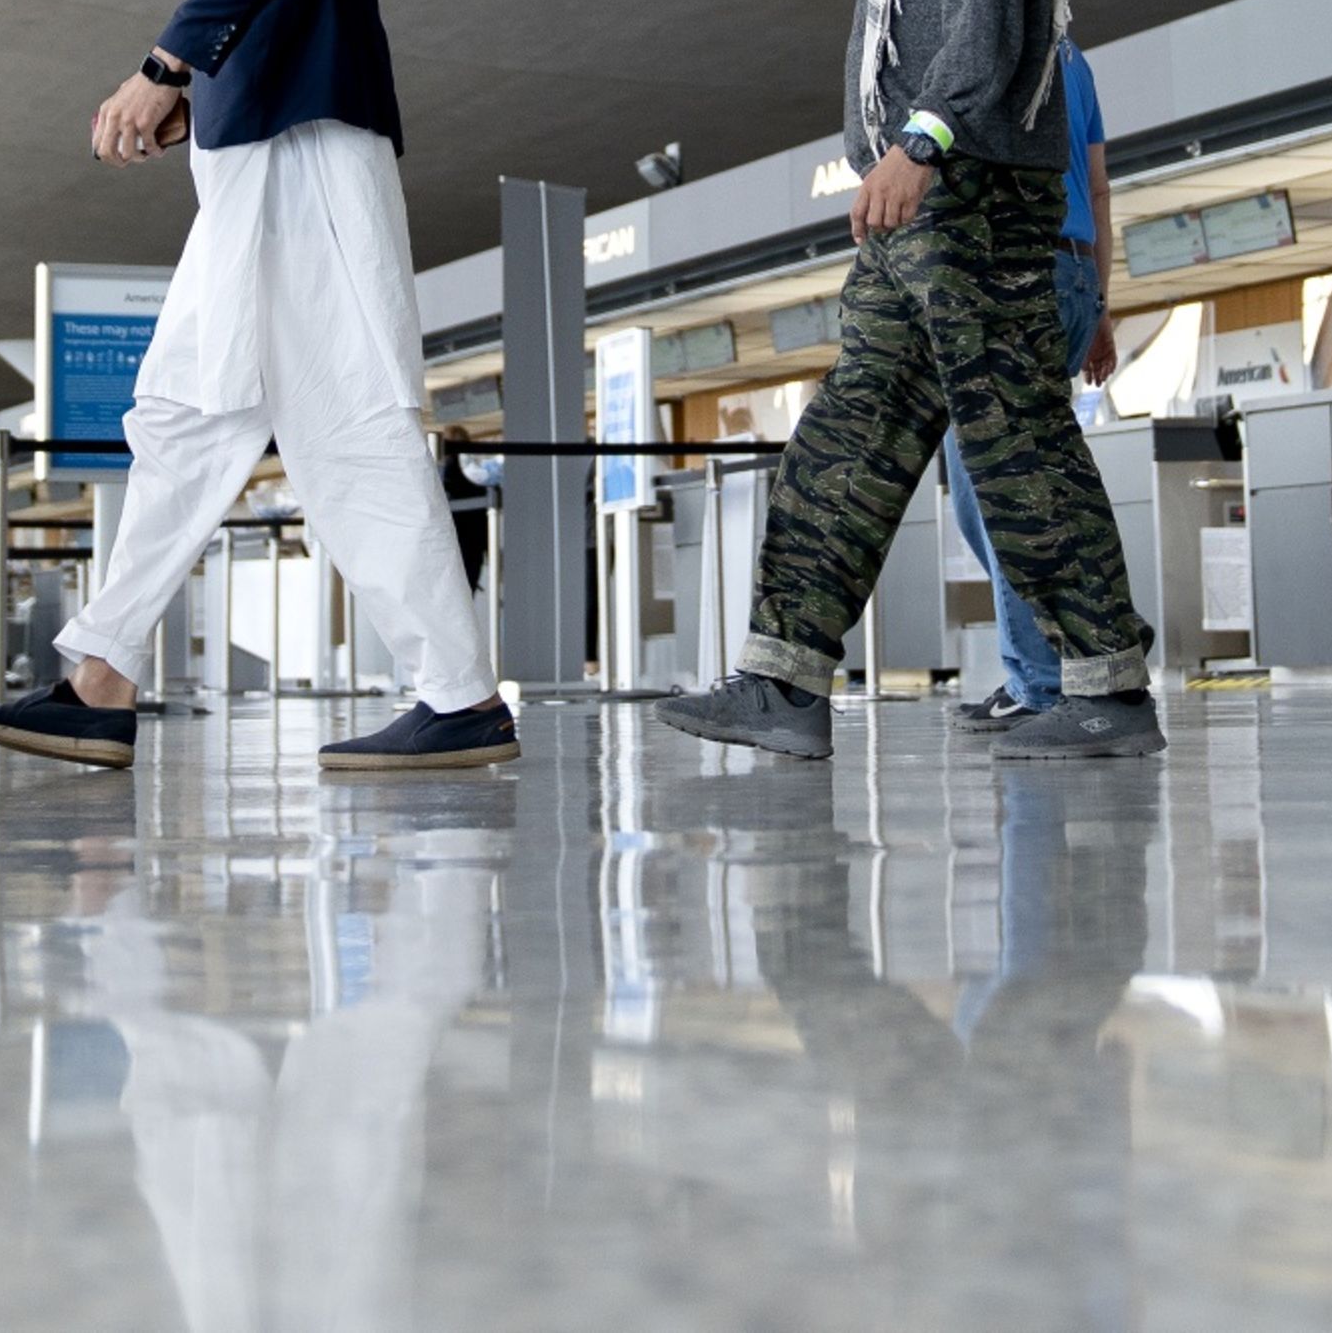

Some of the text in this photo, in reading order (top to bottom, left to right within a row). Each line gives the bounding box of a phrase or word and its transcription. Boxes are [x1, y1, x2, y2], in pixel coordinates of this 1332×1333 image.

[65, 321, 153, 339] These may not
[1217, 361, 1272, 386] American
